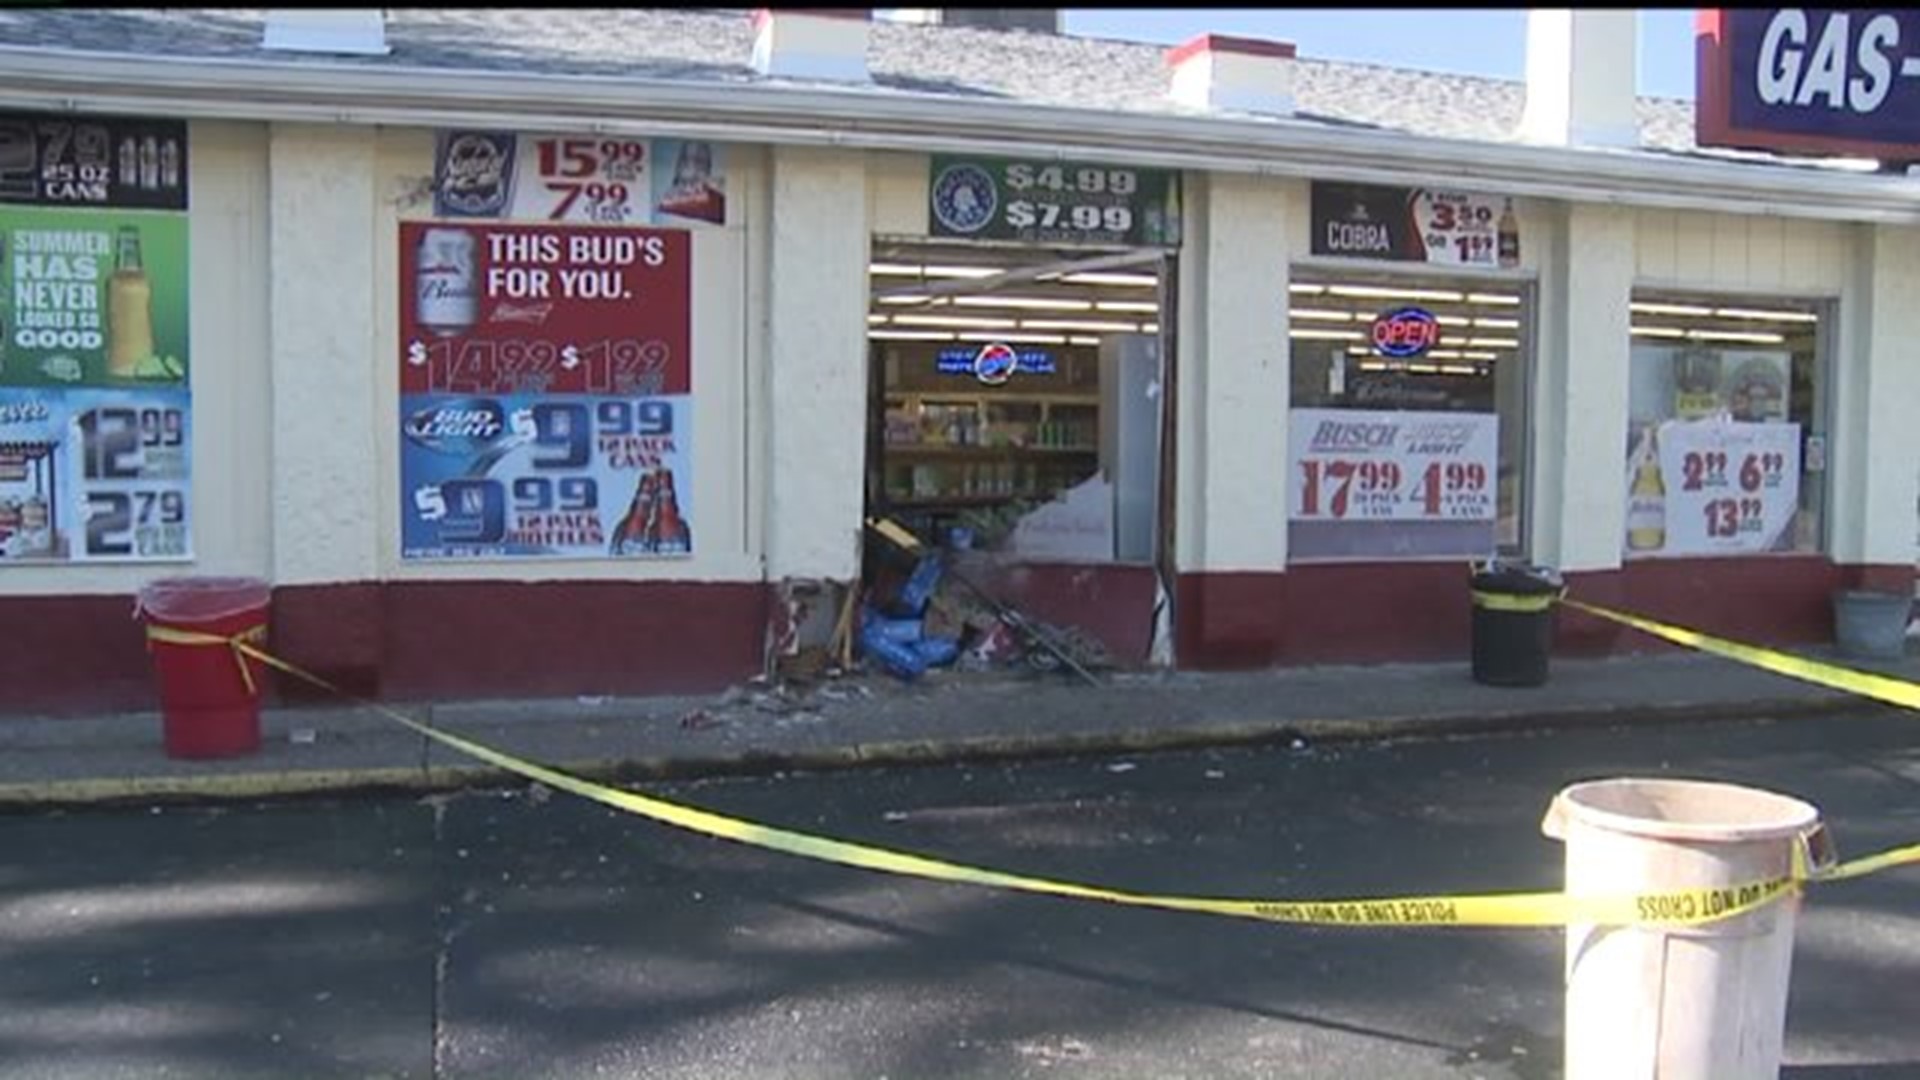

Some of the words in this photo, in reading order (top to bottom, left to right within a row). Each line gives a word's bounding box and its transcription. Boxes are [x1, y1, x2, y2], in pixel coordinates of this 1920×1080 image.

[46, 182, 108, 200] CANS
[1006, 164, 1137, 194] $4.99
[1006, 200, 1133, 231] $7.99
[14, 230, 110, 255] SUMMER
[1327, 221, 1391, 251] COBRA
[487, 234, 560, 263] THIS
[569, 235, 665, 265] BUD'S
[14, 256, 98, 280] HAS
[15, 282, 98, 310] NEVER
[488, 268, 549, 298] FOR
[560, 270, 632, 299] YOU.
[15, 329, 103, 350] GOOD
[1372, 321, 1438, 346] OPEN
[432, 409, 494, 424] BUD
[419, 422, 502, 437] LIGHT
[1311, 420, 1399, 447] BUSCH
[1364, 903, 1398, 922] LINE
[1401, 902, 1458, 922] POLICE
[1636, 895, 1696, 920] CROSS
[1702, 889, 1736, 916] NOT
